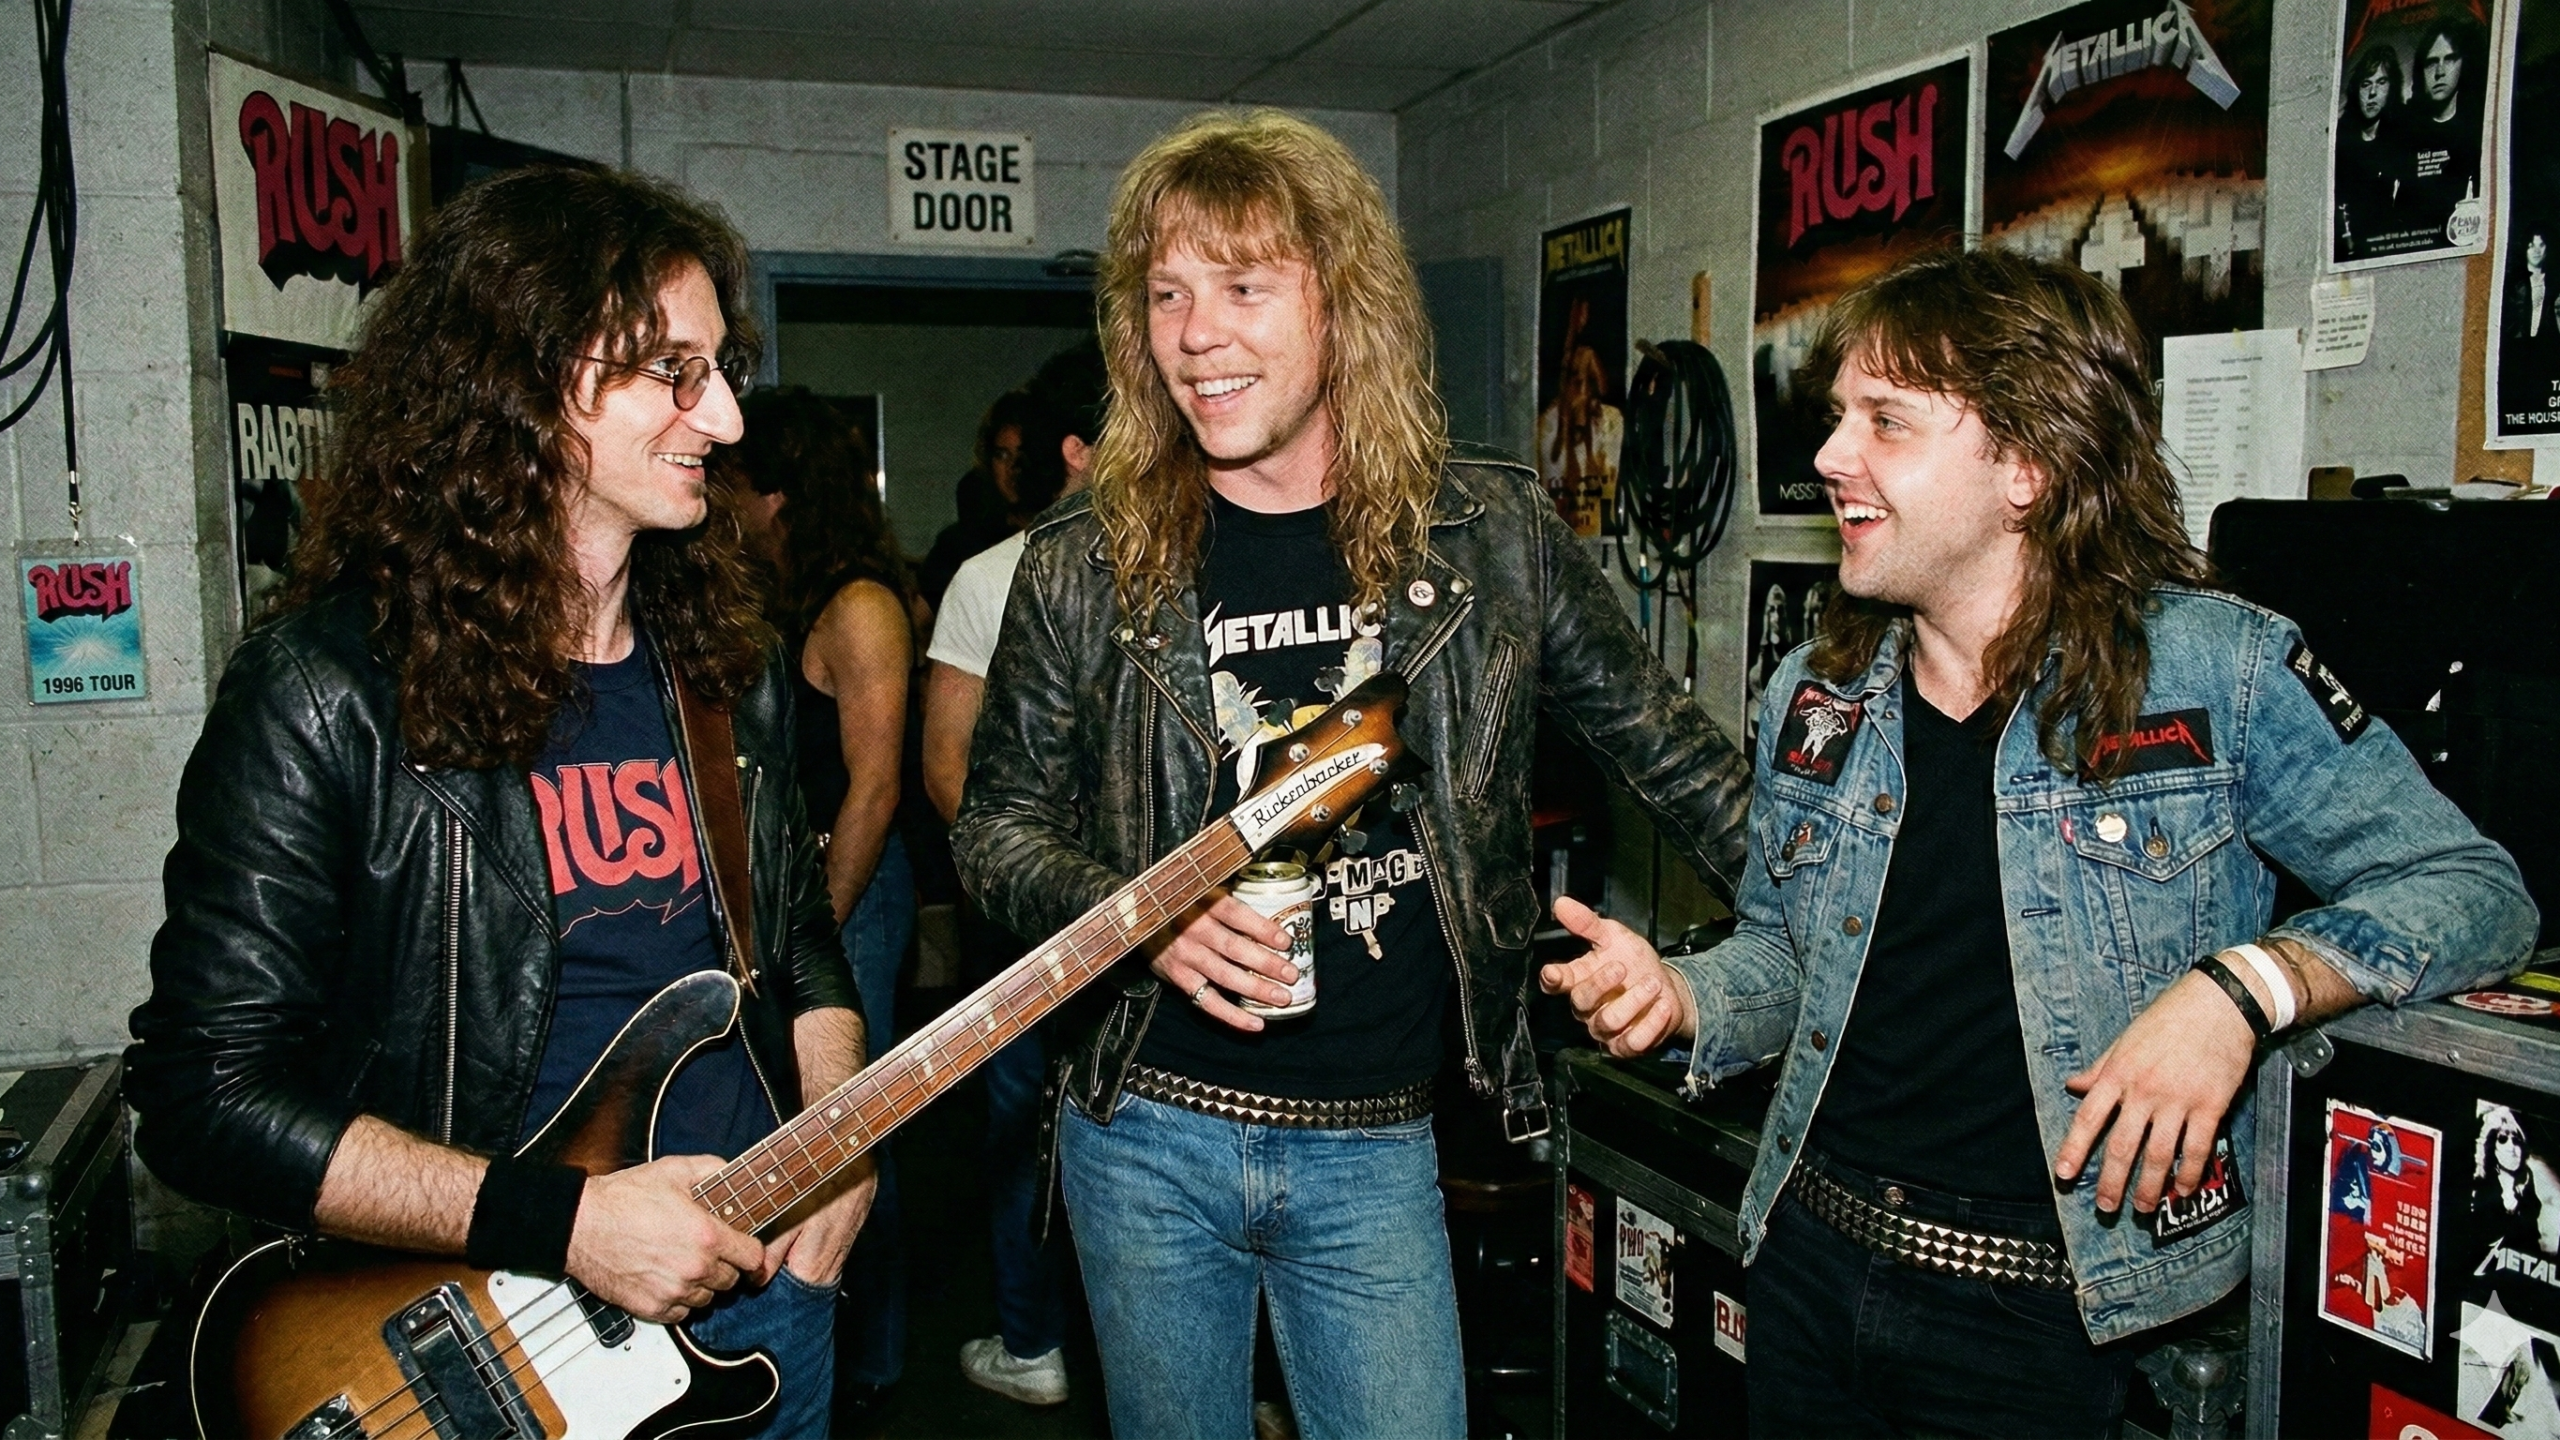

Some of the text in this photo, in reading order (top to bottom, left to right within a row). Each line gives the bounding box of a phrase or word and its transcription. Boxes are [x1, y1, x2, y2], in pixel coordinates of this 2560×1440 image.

[2004, 0, 2241, 161] METALLICA
[239, 90, 402, 283] RUSH
[905, 141, 1021, 183] STAGE
[1782, 84, 1937, 249] RUSH
[913, 192, 1012, 232] DOOR
[2551, 380, 2560, 391] T
[2505, 413, 2526, 425] THE
[28, 561, 132, 618] RUSH
[42, 674, 136, 694] 1996 TOUR
[2089, 718, 2211, 769] MEALLICA
[1252, 752, 1360, 829] Rickenbacker
